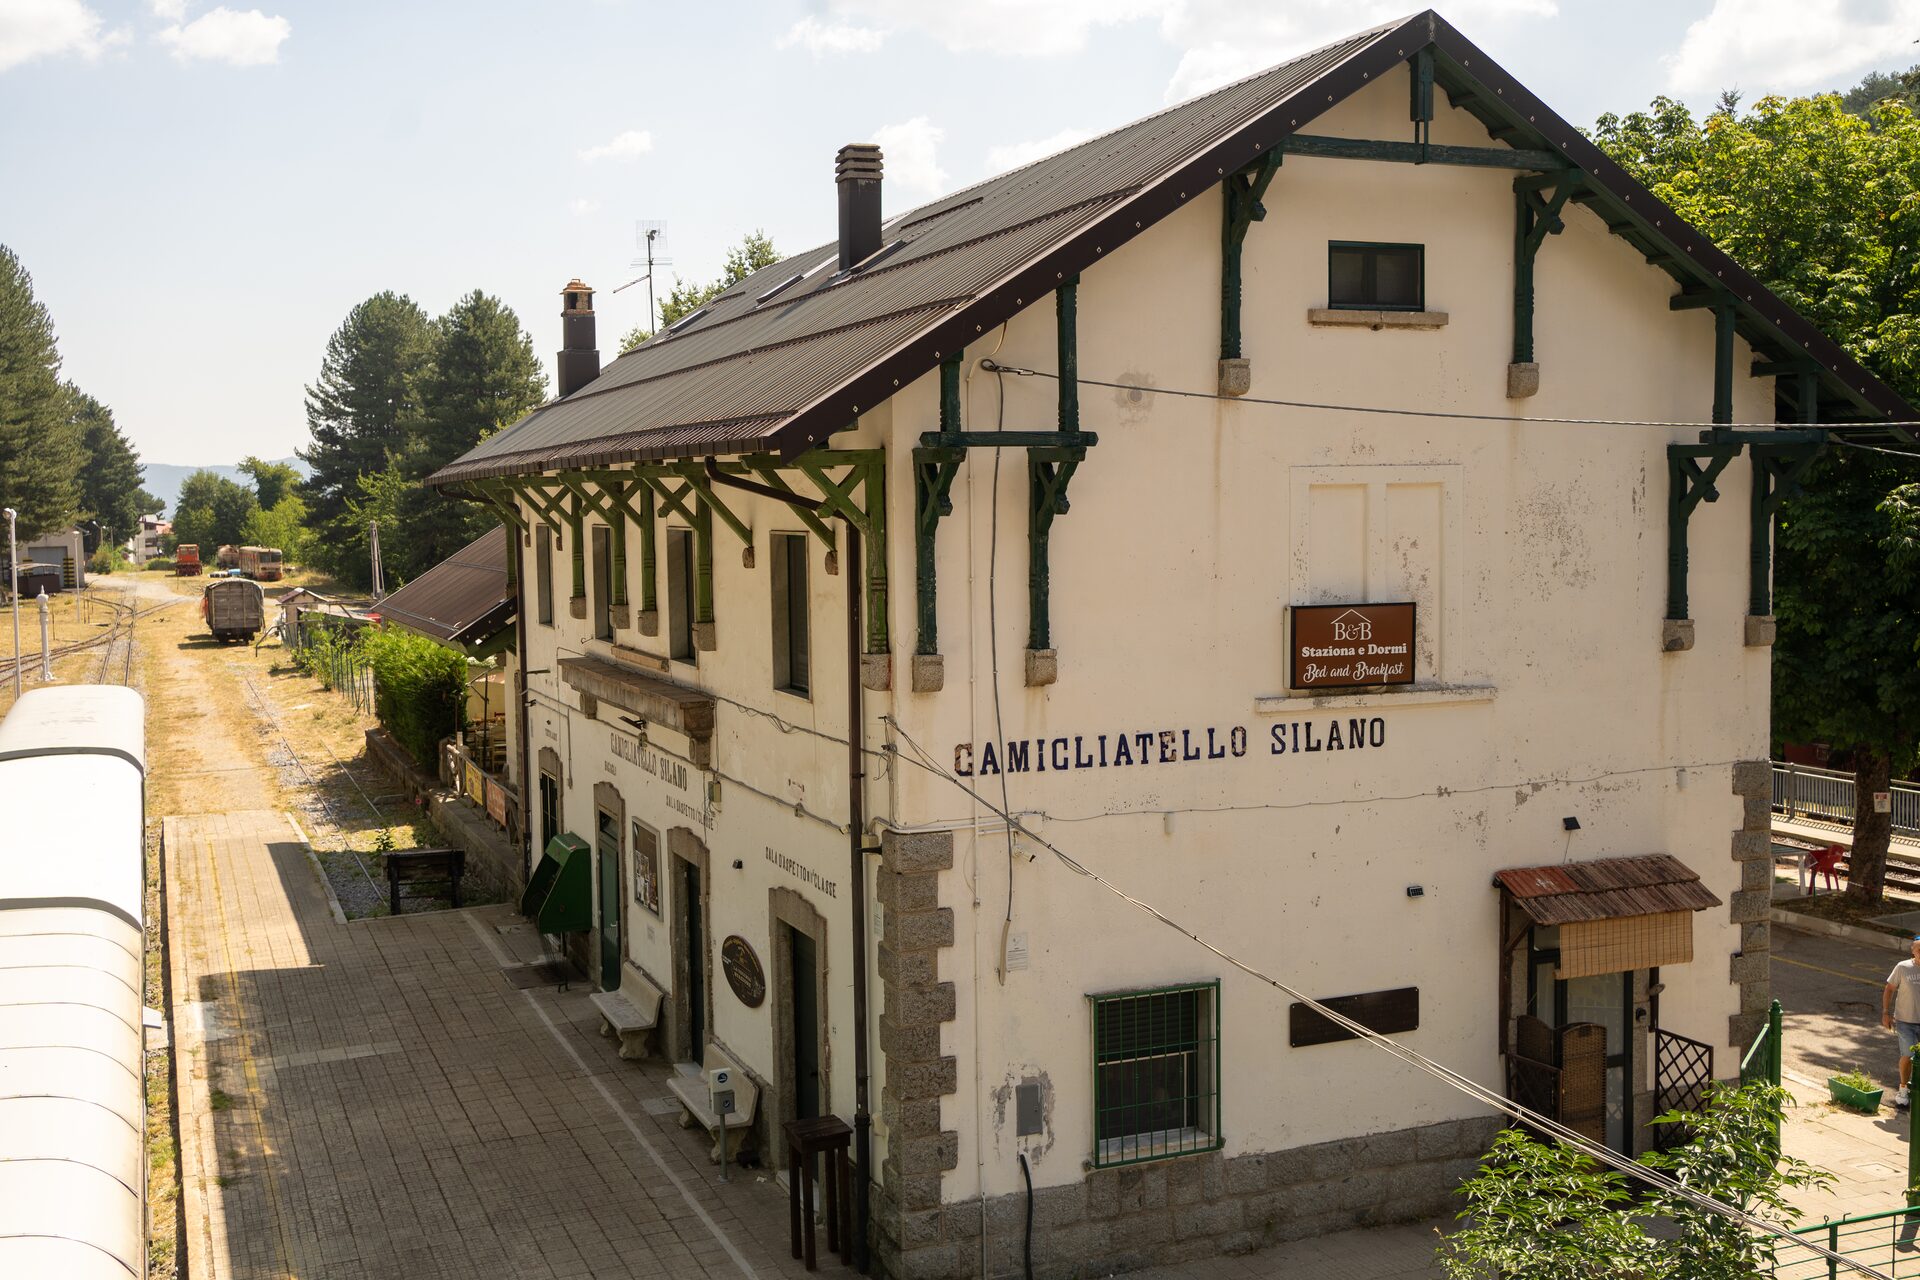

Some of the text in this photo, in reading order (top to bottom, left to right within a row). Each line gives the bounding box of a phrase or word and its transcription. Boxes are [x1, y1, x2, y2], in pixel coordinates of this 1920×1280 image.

[1334, 622, 1372, 641] B&B
[1302, 643, 1407, 657] Staziona e Dormi
[1303, 661, 1404, 683] Bed and Breakfast
[1271, 717, 1385, 755] SILANO
[660, 757, 687, 791] SILANO
